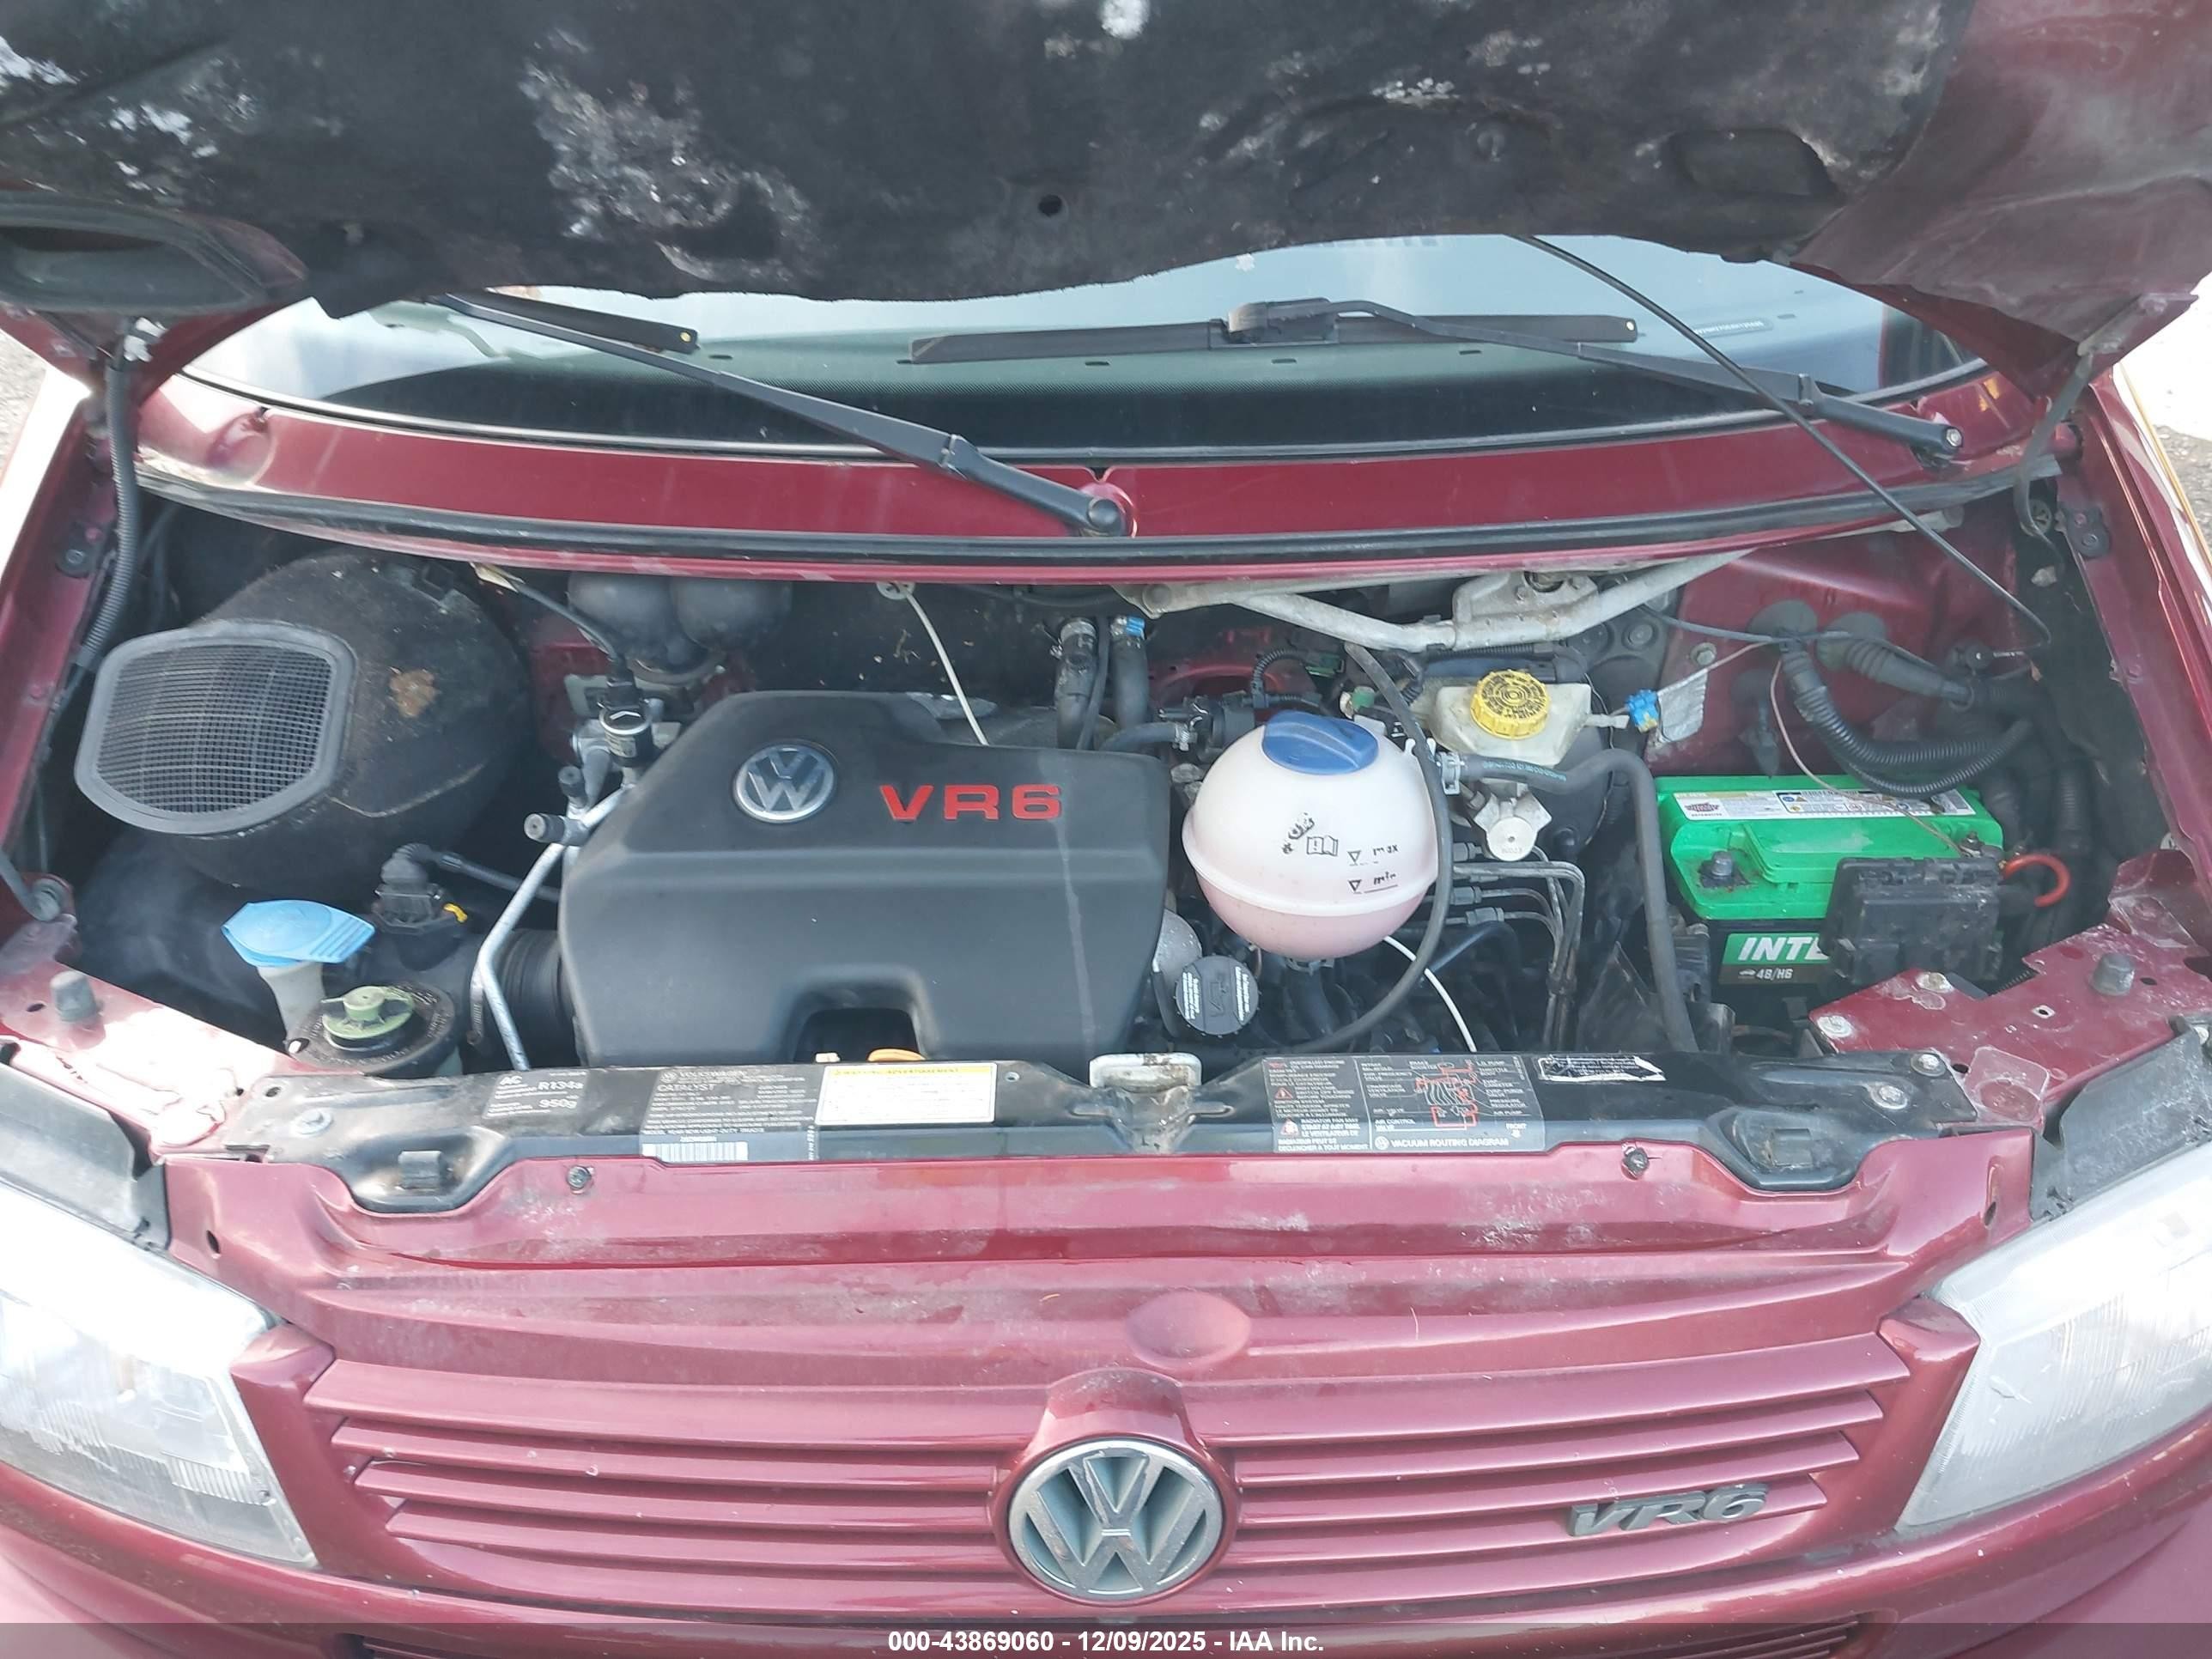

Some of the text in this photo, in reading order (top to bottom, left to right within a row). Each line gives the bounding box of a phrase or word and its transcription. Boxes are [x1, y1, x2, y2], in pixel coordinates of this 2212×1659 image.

[879, 783, 1062, 822] VR6
[500, 1075, 522, 1085] AC
[538, 1098, 578, 1109] 950g
[1390, 1137, 1510, 1148] VACUUM ROUTING DIAGRAM
[1567, 1484, 1771, 1538] VR6
